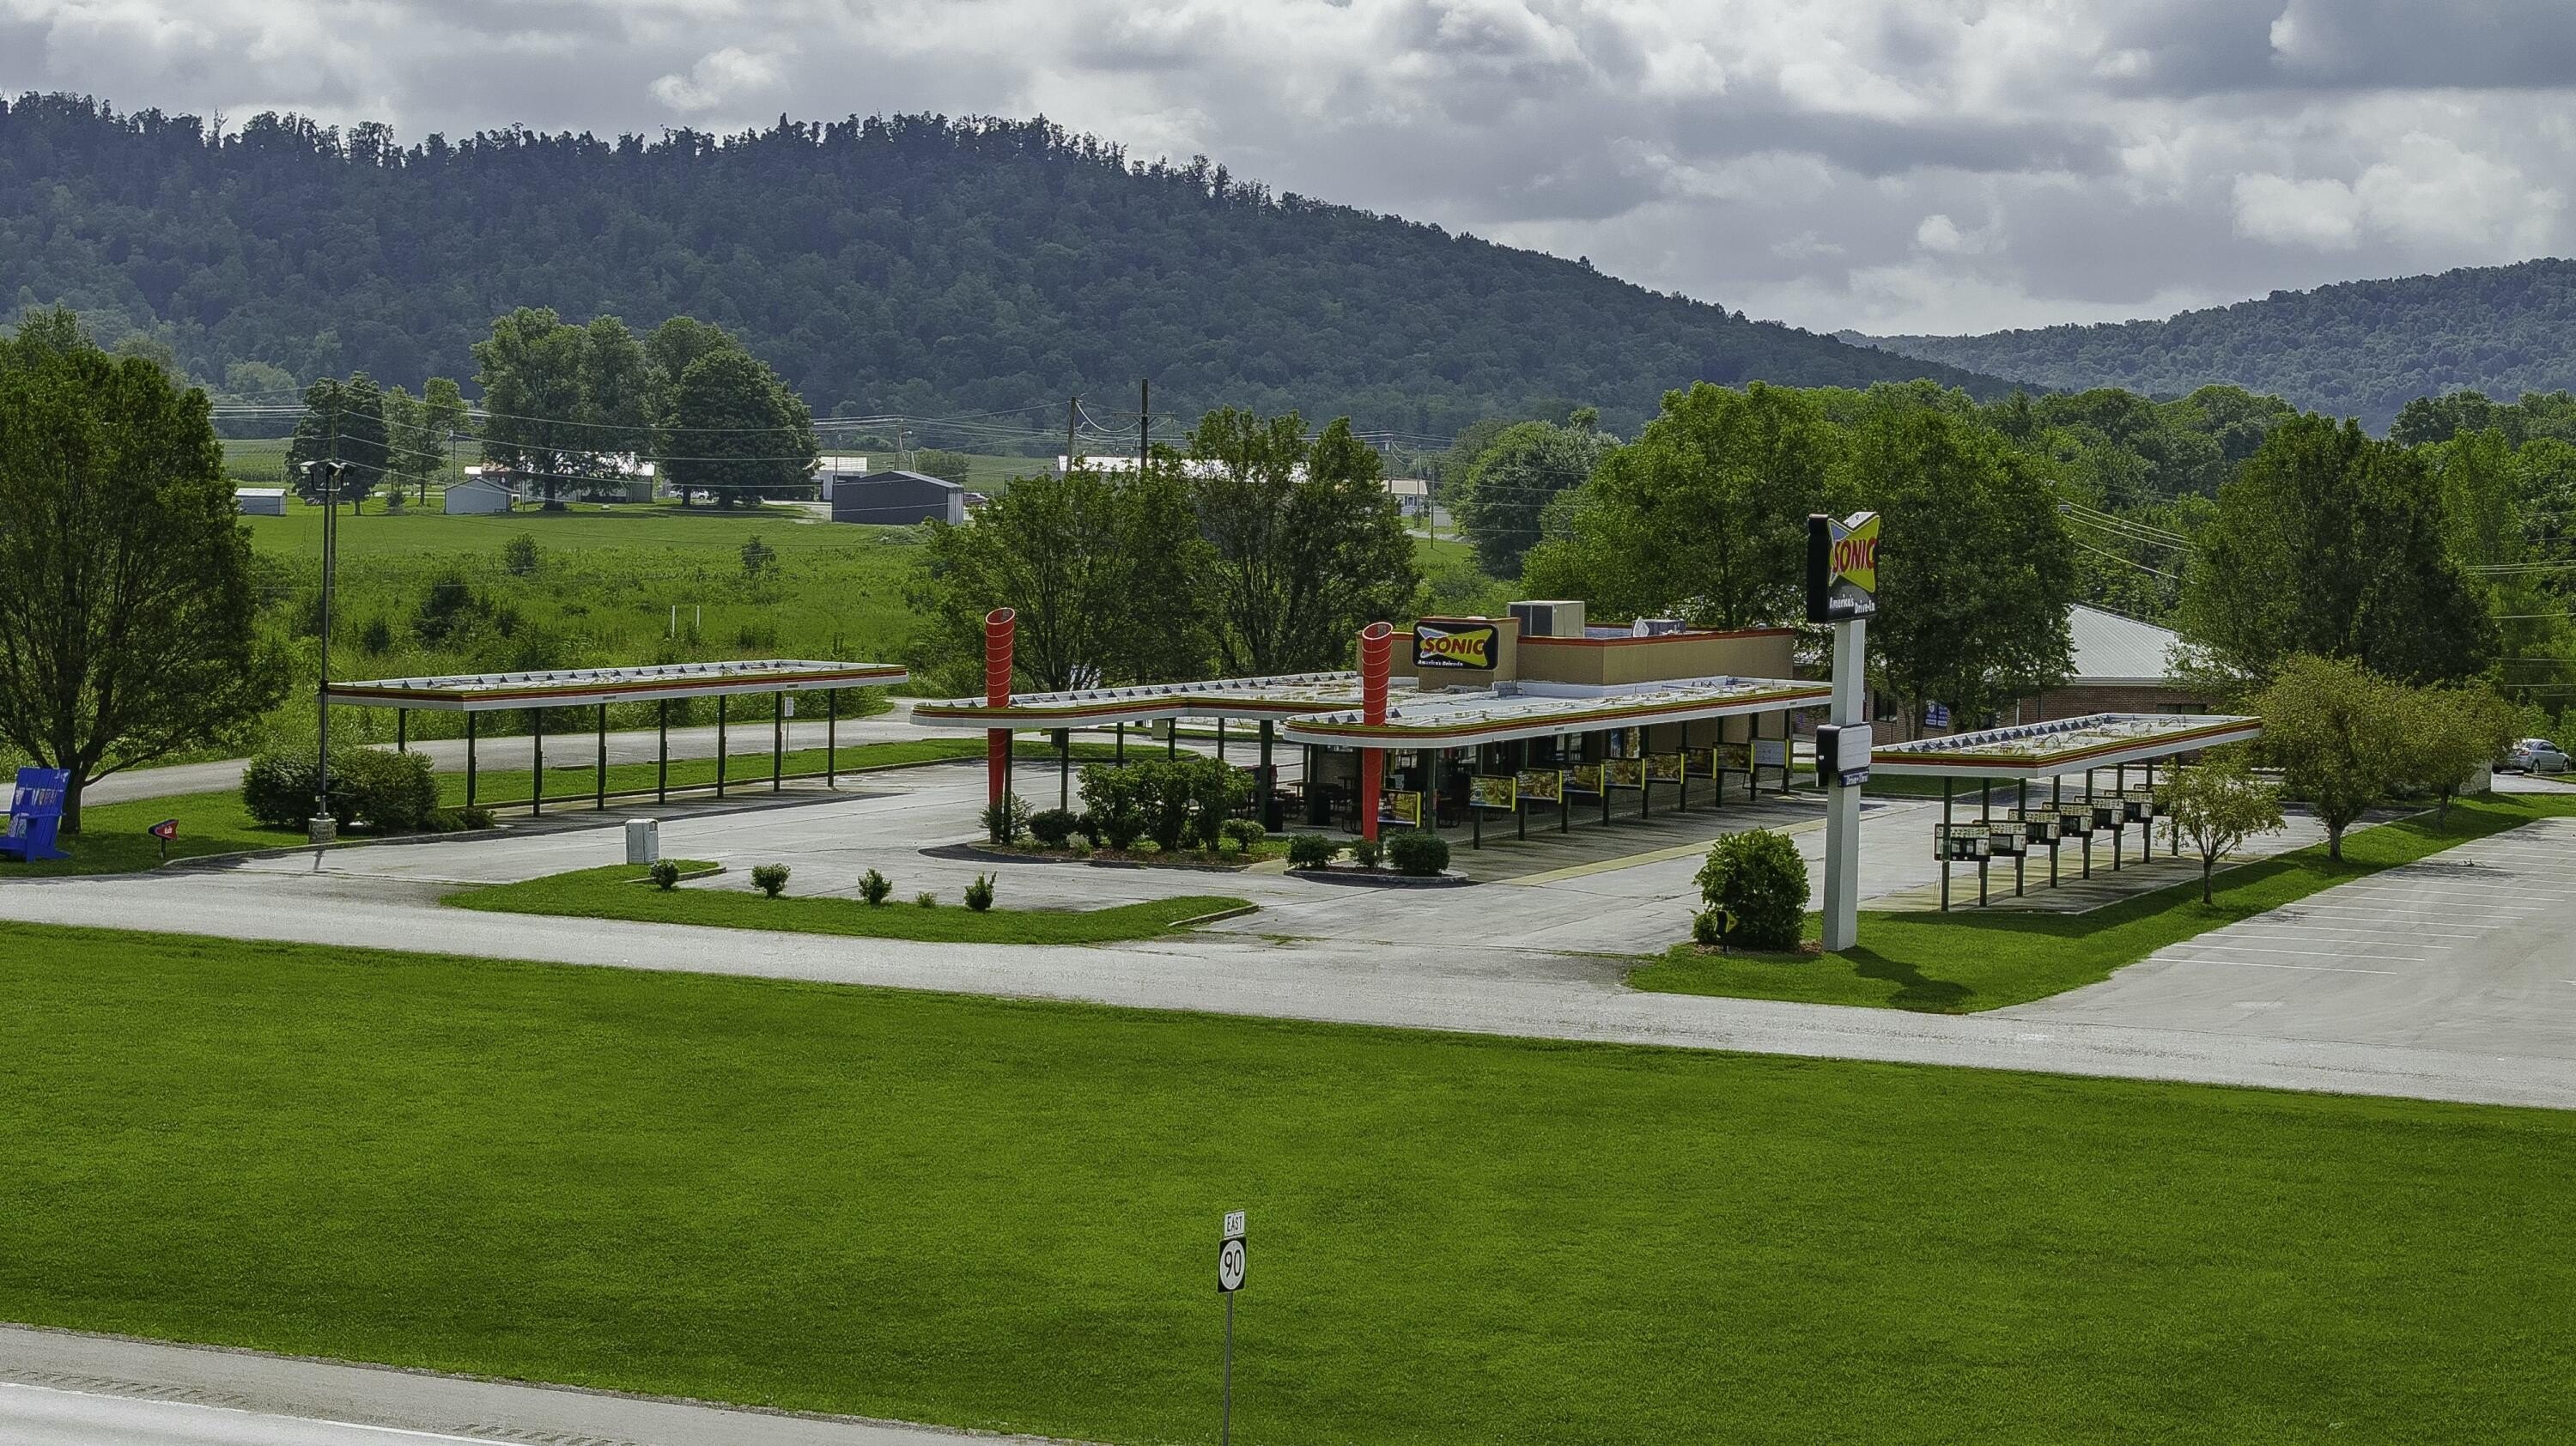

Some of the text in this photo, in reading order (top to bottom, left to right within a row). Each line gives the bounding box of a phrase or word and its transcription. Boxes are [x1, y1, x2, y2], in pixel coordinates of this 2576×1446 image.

[1832, 537, 1877, 573] SONIC
[1829, 593, 1854, 610] America's
[1425, 637, 1485, 655] SONIC
[1227, 1216, 1242, 1232] EAST
[1224, 1249, 1242, 1278] 90
